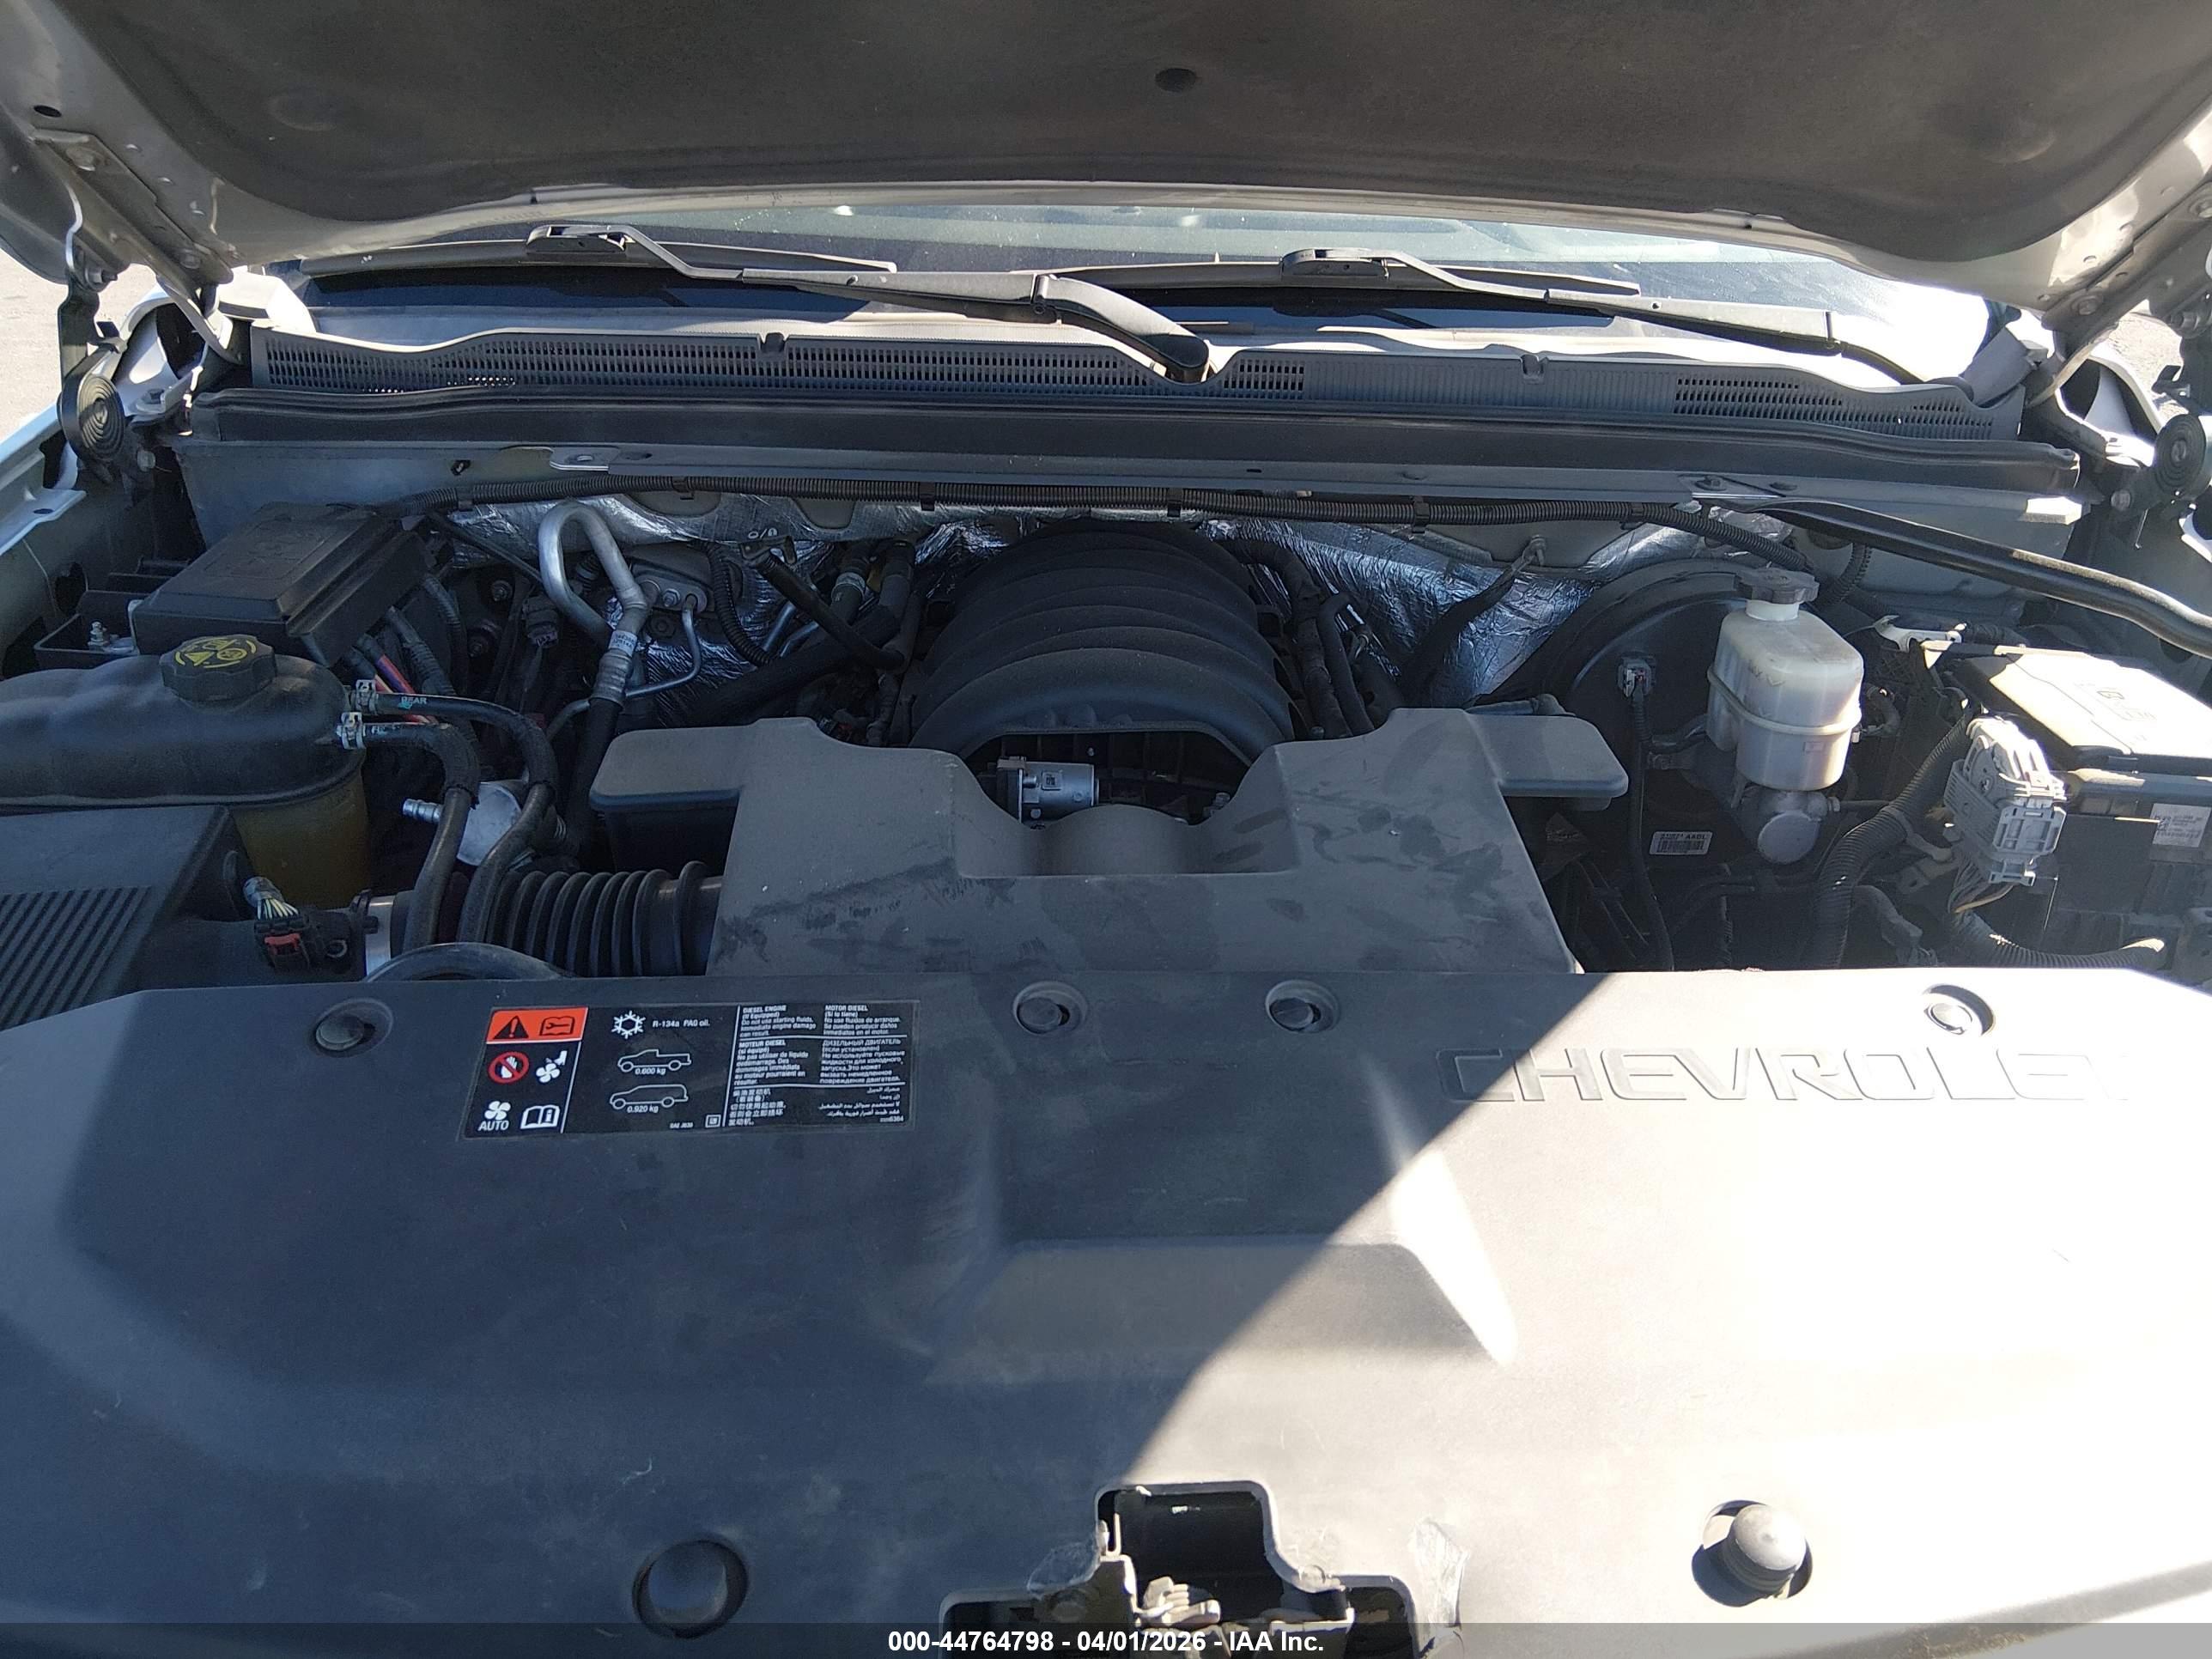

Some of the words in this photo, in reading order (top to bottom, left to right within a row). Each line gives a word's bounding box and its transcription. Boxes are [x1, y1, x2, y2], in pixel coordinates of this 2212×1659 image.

[1436, 1047, 2129, 1103] CHEVROLE
[649, 1104, 659, 1113] kg
[477, 1121, 509, 1131] AUTO
